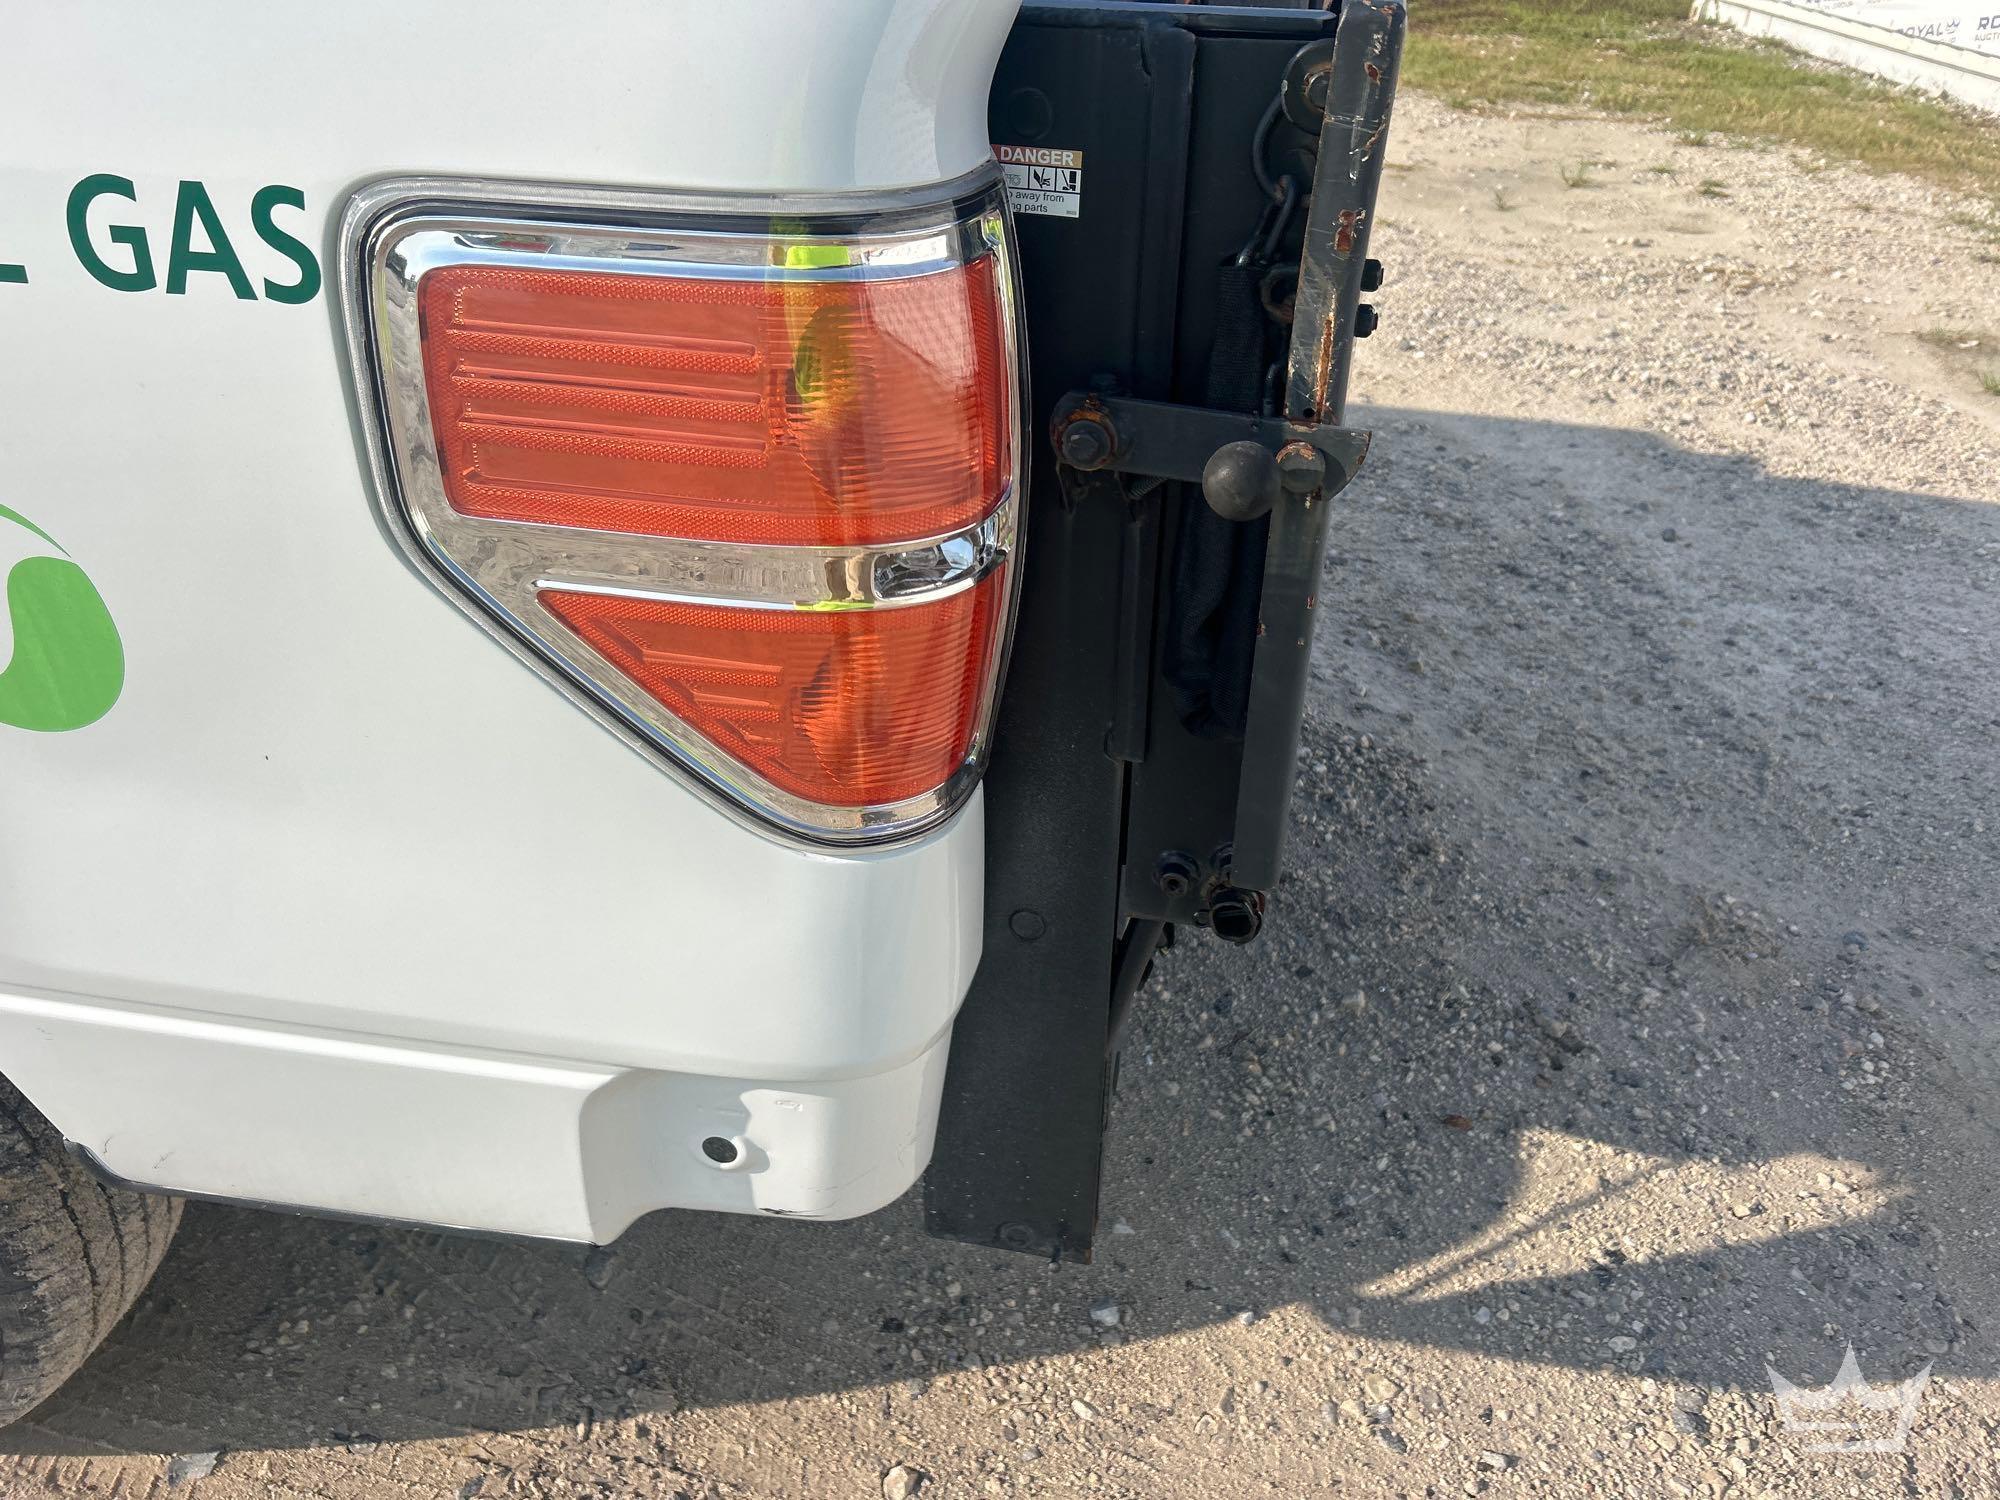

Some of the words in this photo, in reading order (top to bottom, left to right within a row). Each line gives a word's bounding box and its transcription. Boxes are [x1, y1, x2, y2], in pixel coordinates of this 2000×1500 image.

[1000, 146, 1074, 166] DANGER
[1015, 191, 1041, 203] away
[1043, 192, 1065, 203] from
[1024, 203, 1048, 213] parts
[66, 174, 321, 304] GAS
